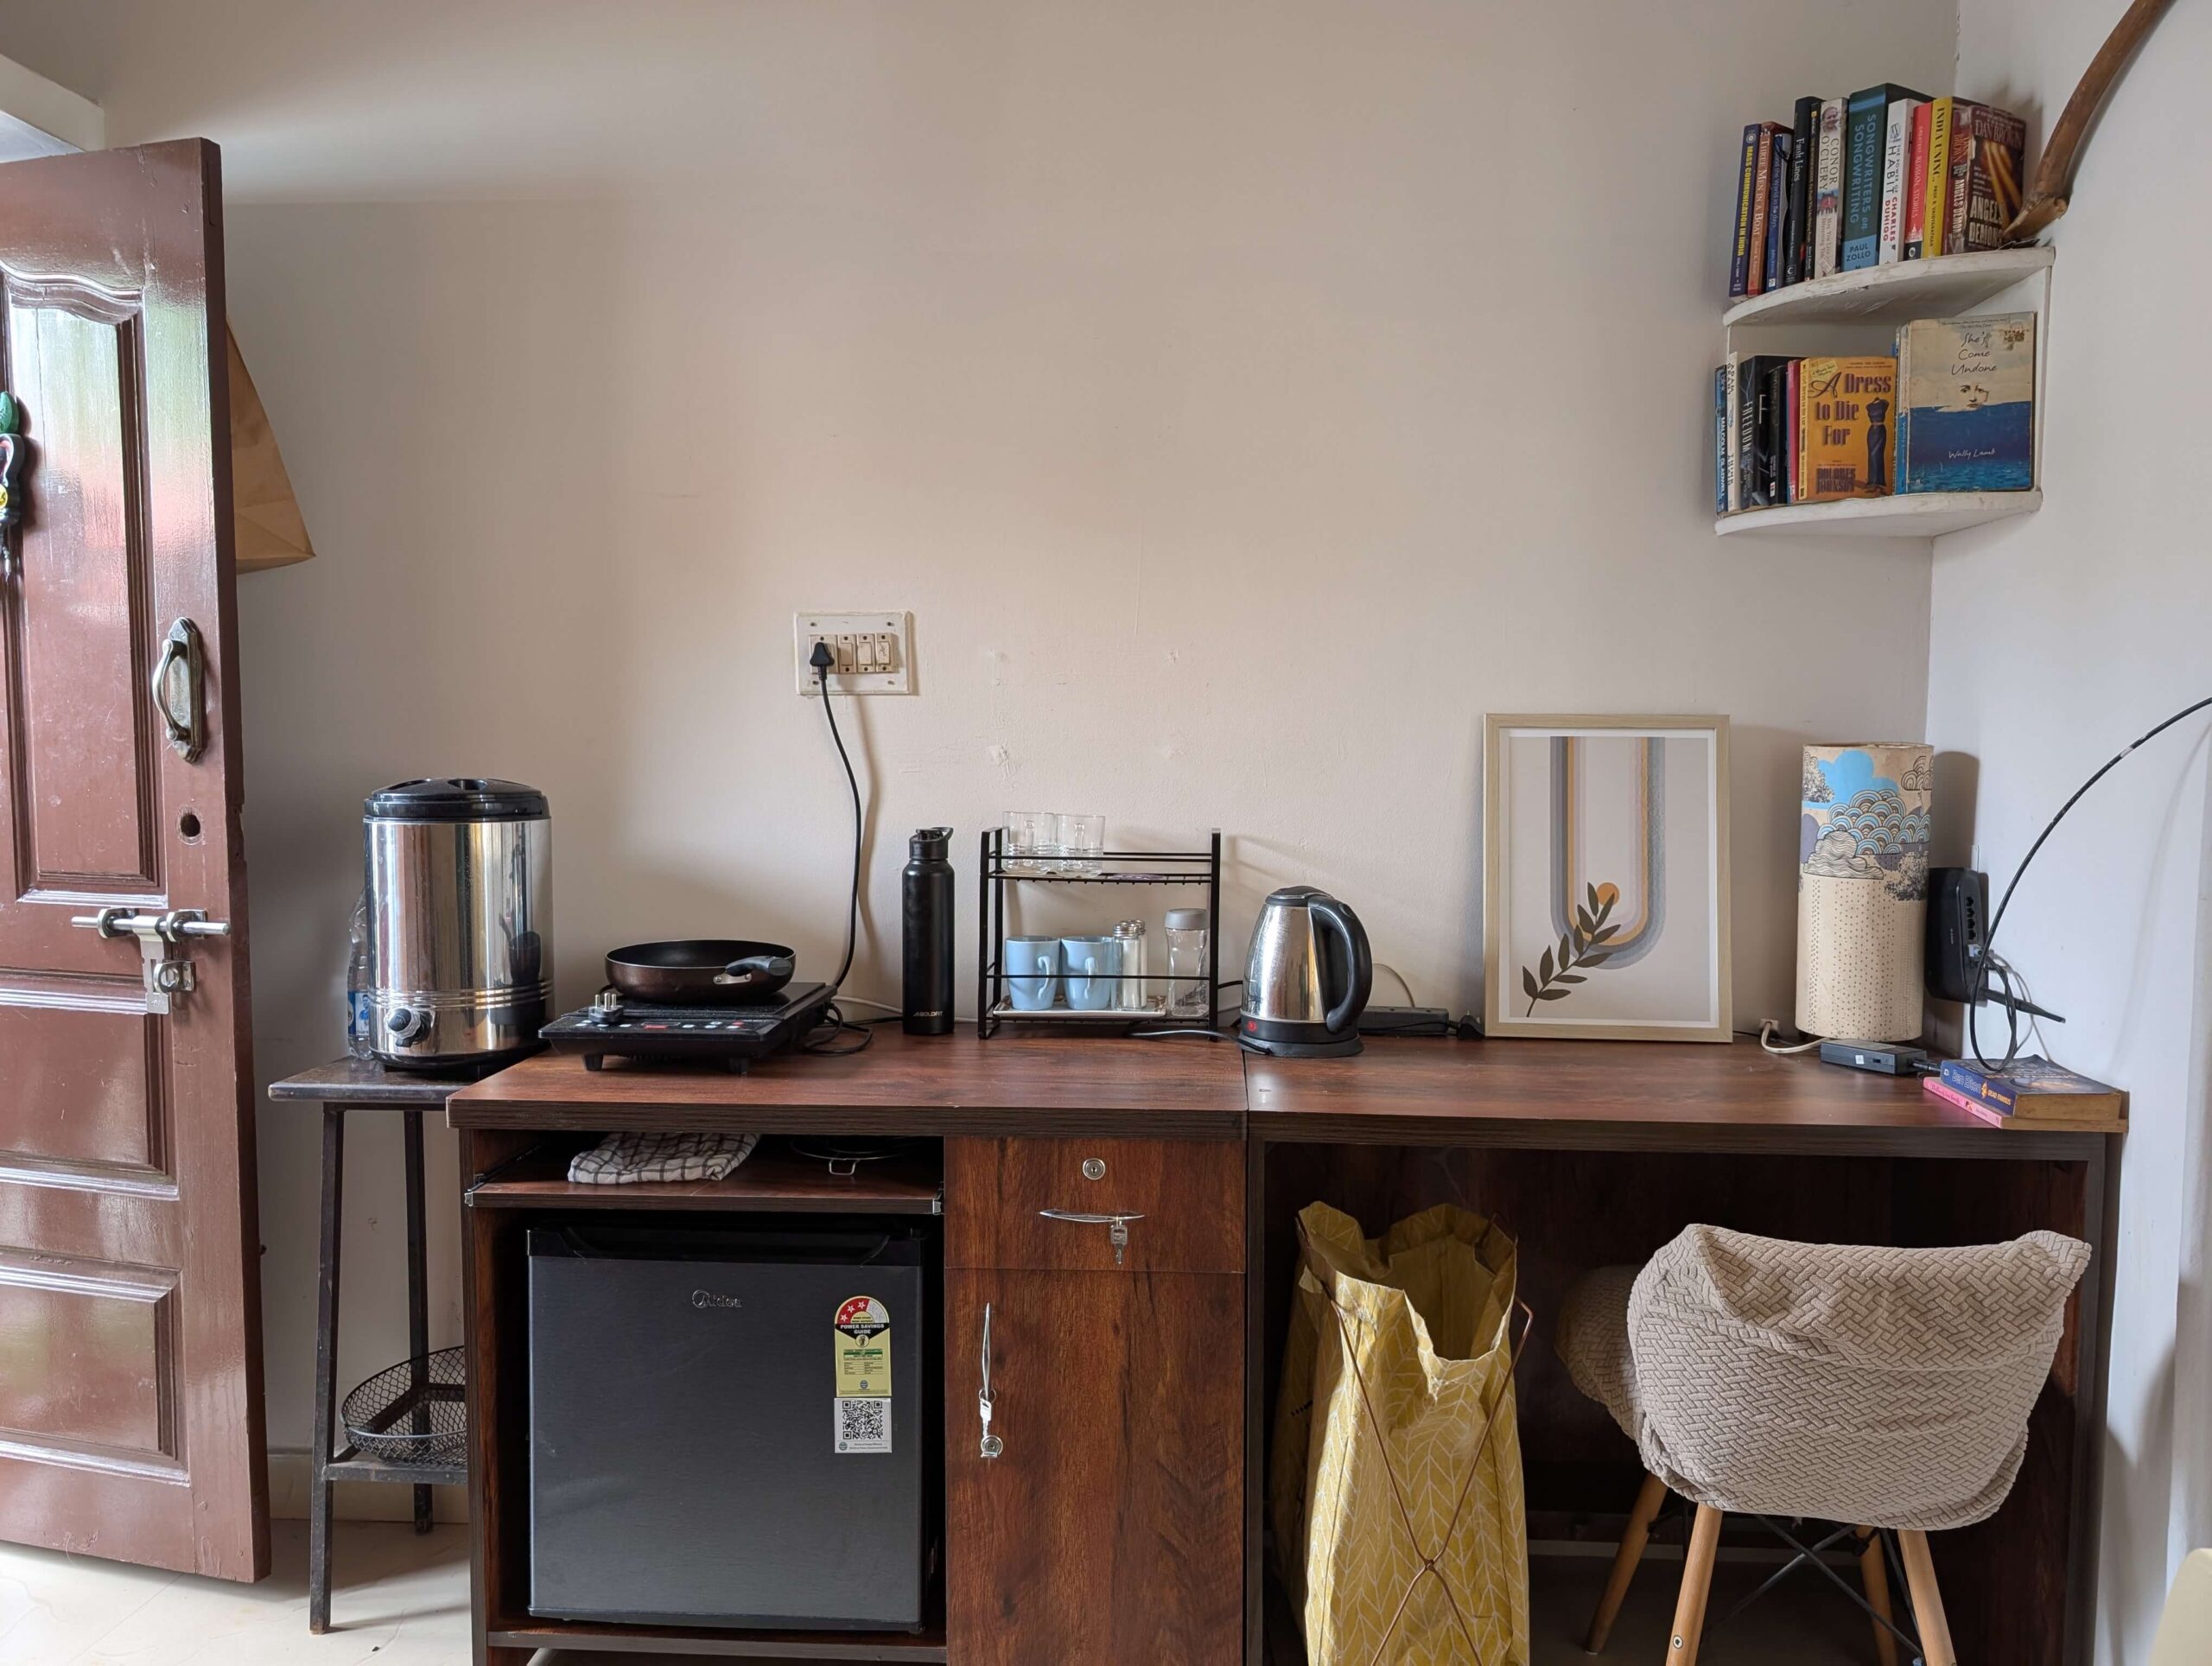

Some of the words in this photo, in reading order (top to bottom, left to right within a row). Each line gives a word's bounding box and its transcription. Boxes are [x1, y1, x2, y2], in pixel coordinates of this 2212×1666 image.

[1935, 107, 1945, 140] INDIA
[1975, 119, 1993, 140] DAN
[1745, 146, 1754, 166] MASS
[1758, 140, 1770, 167] THREE
[1796, 138, 1805, 159] Fault
[1953, 133, 1963, 163] BROWN
[1794, 160, 1804, 181] Lines
[1820, 136, 1830, 190] O'CLERY
[1830, 138, 1840, 184] CONOR
[1862, 114, 1877, 213] SONGWRITERS
[1886, 145, 1897, 194] HABIT
[1757, 169, 1767, 189] MEN
[1850, 124, 1865, 223] SONGWRITING
[1913, 156, 1923, 188] RUSSIAN
[1740, 167, 1751, 226] COMMUNICATION
[1756, 193, 1763, 201] IN
[1894, 185, 1898, 194] OF
[1954, 179, 1965, 207] ANGELS
[1910, 189, 1921, 218] STORIES
[1752, 213, 1764, 235] BOAT
[1861, 218, 1868, 232] on
[1737, 236, 1745, 256] INDIA
[1846, 251, 1871, 262] ZOLLO
[1849, 243, 1869, 252] PAUL
[1961, 332, 1988, 347] She's
[1958, 349, 1991, 360] Come
[1951, 362, 1997, 375] Undone
[1808, 372, 1842, 398] A
[1845, 373, 1891, 393] Dress
[1816, 401, 1831, 420] to
[1835, 400, 1859, 420] Die
[1742, 401, 1753, 453] FREEDOM
[1823, 425, 1851, 446] For
[1948, 449, 1972, 460] Wally
[1973, 448, 1995, 457] Lamb
[1952, 1069, 1965, 1086] Ben
[1964, 1072, 1981, 1094] Elton
